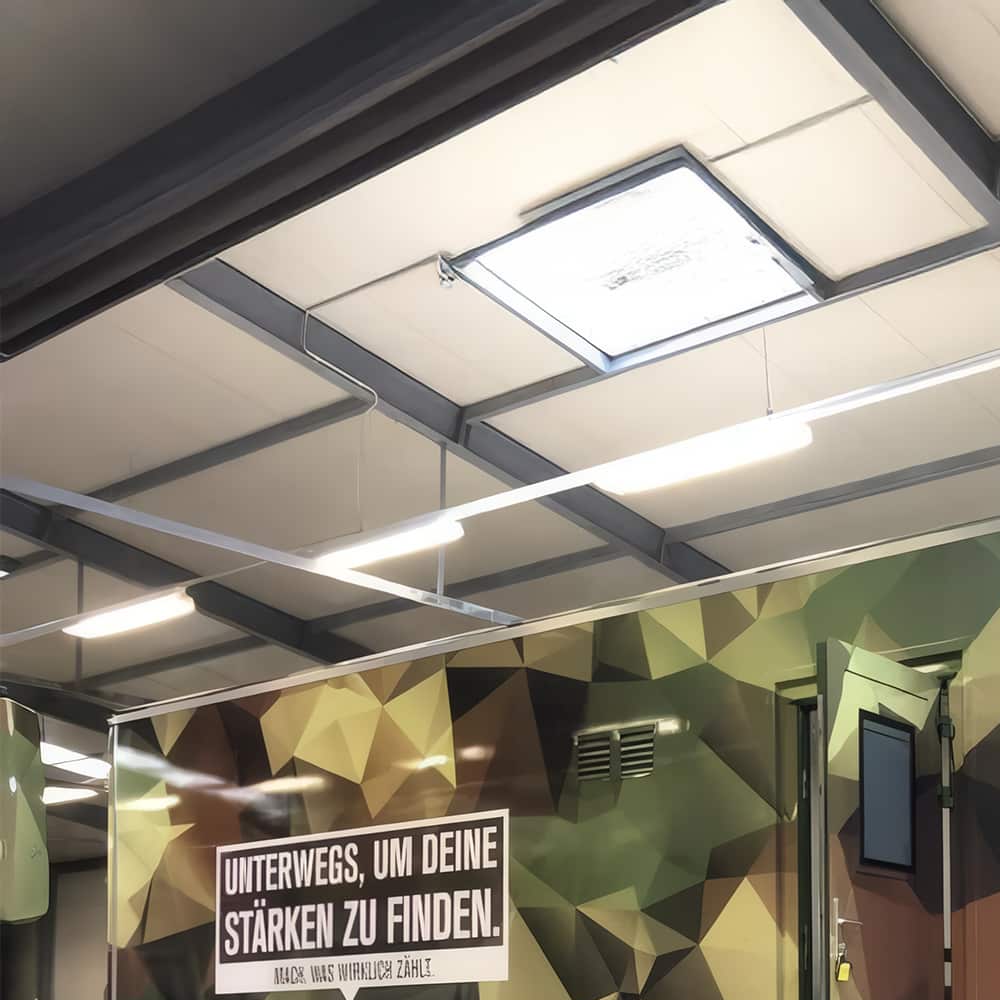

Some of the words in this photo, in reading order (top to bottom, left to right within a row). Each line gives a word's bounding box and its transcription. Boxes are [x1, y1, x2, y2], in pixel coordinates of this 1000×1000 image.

[224, 842, 364, 895] UNTERWEGS,
[373, 836, 413, 880] UM
[422, 826, 498, 875] DEINE
[224, 898, 334, 956] STÄRKEN
[342, 898, 377, 947] ZU
[386, 888, 501, 944] FINDEN.
